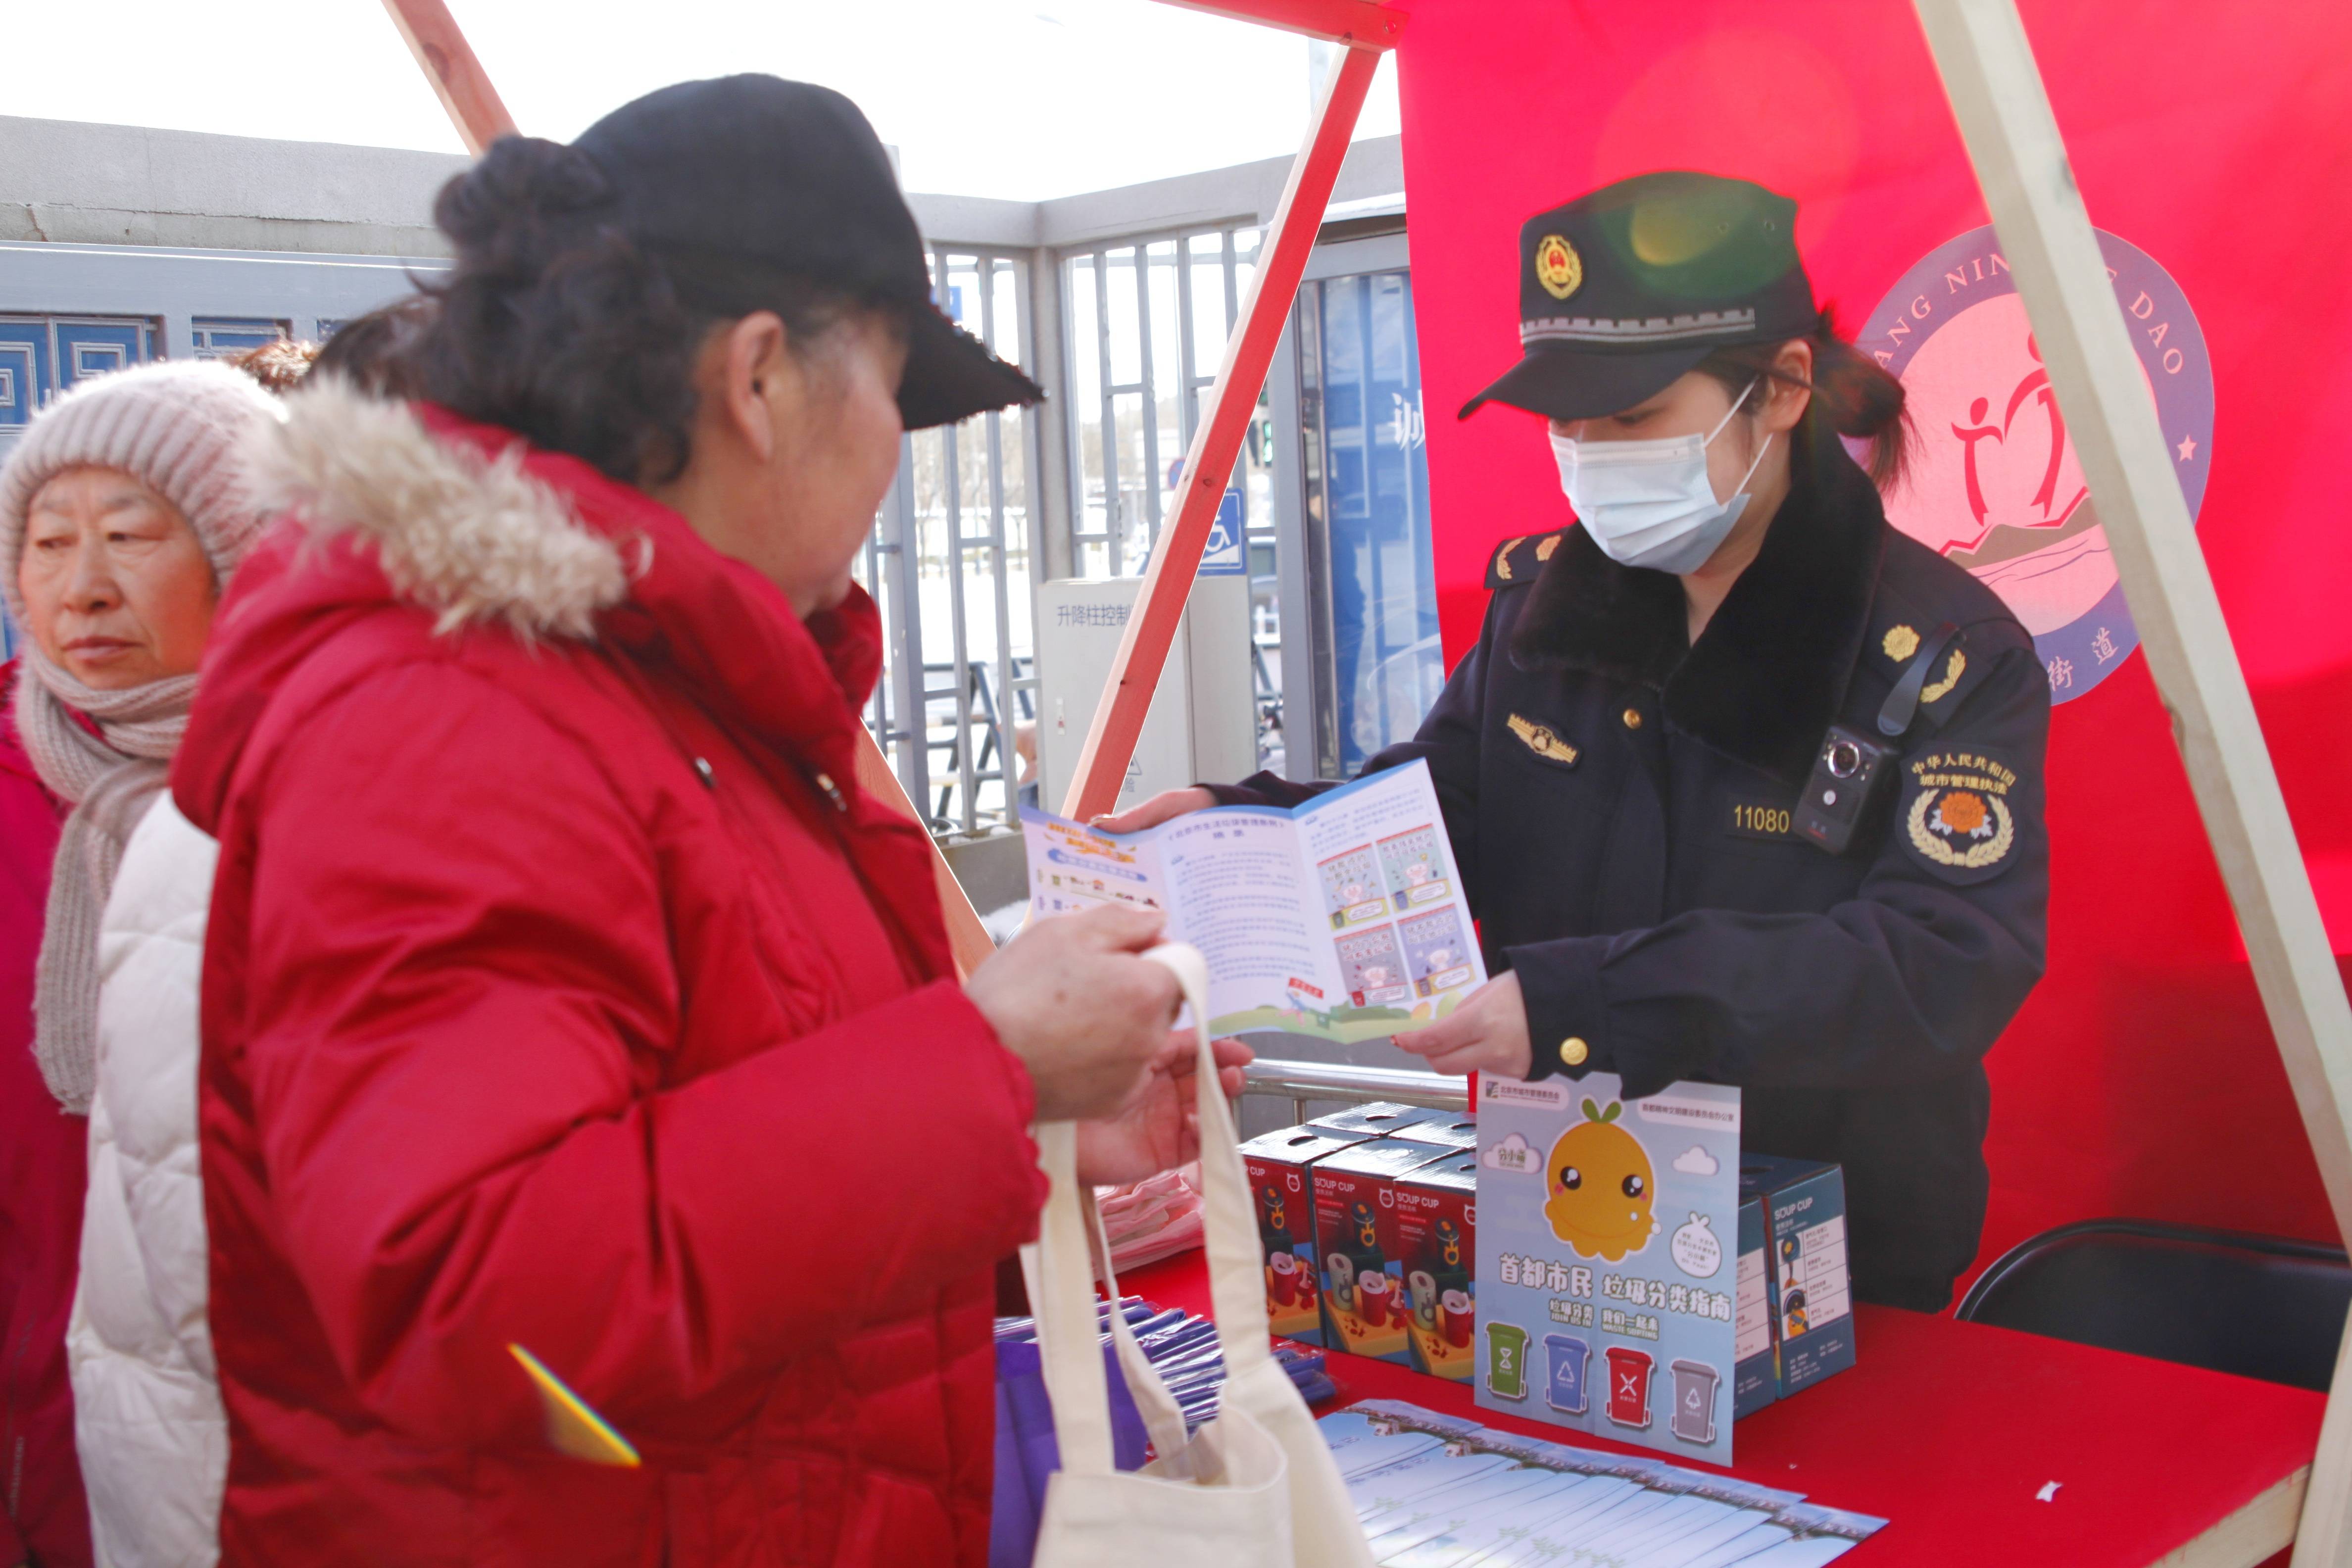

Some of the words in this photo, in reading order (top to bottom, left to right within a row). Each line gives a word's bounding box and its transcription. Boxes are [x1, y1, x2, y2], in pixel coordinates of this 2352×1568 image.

[1944, 252, 2010, 294] NIN
[2128, 291, 2184, 375] DAO
[1057, 603, 1133, 627] 升降柱控制
[1911, 753, 2016, 786] 中华人民共和国
[1919, 774, 2008, 795] 城市管理执法
[1734, 804, 1790, 833] 11080
[1250, 1166, 1266, 1176] CUP
[1314, 1177, 1336, 1189] SOUP
[1338, 1182, 1355, 1192] CUP
[1397, 1192, 1420, 1204] SOUP
[1421, 1197, 1439, 1208] CUP
[1774, 1204, 1796, 1221] SOUP
[1797, 1196, 1813, 1211] CUP
[1500, 1253, 1593, 1298] 首都市民
[1603, 1274, 1732, 1322] 垃圾分类指南
[1550, 1298, 1594, 1321] 垃圾分类
[1602, 1308, 1659, 1331] 我们一起来
